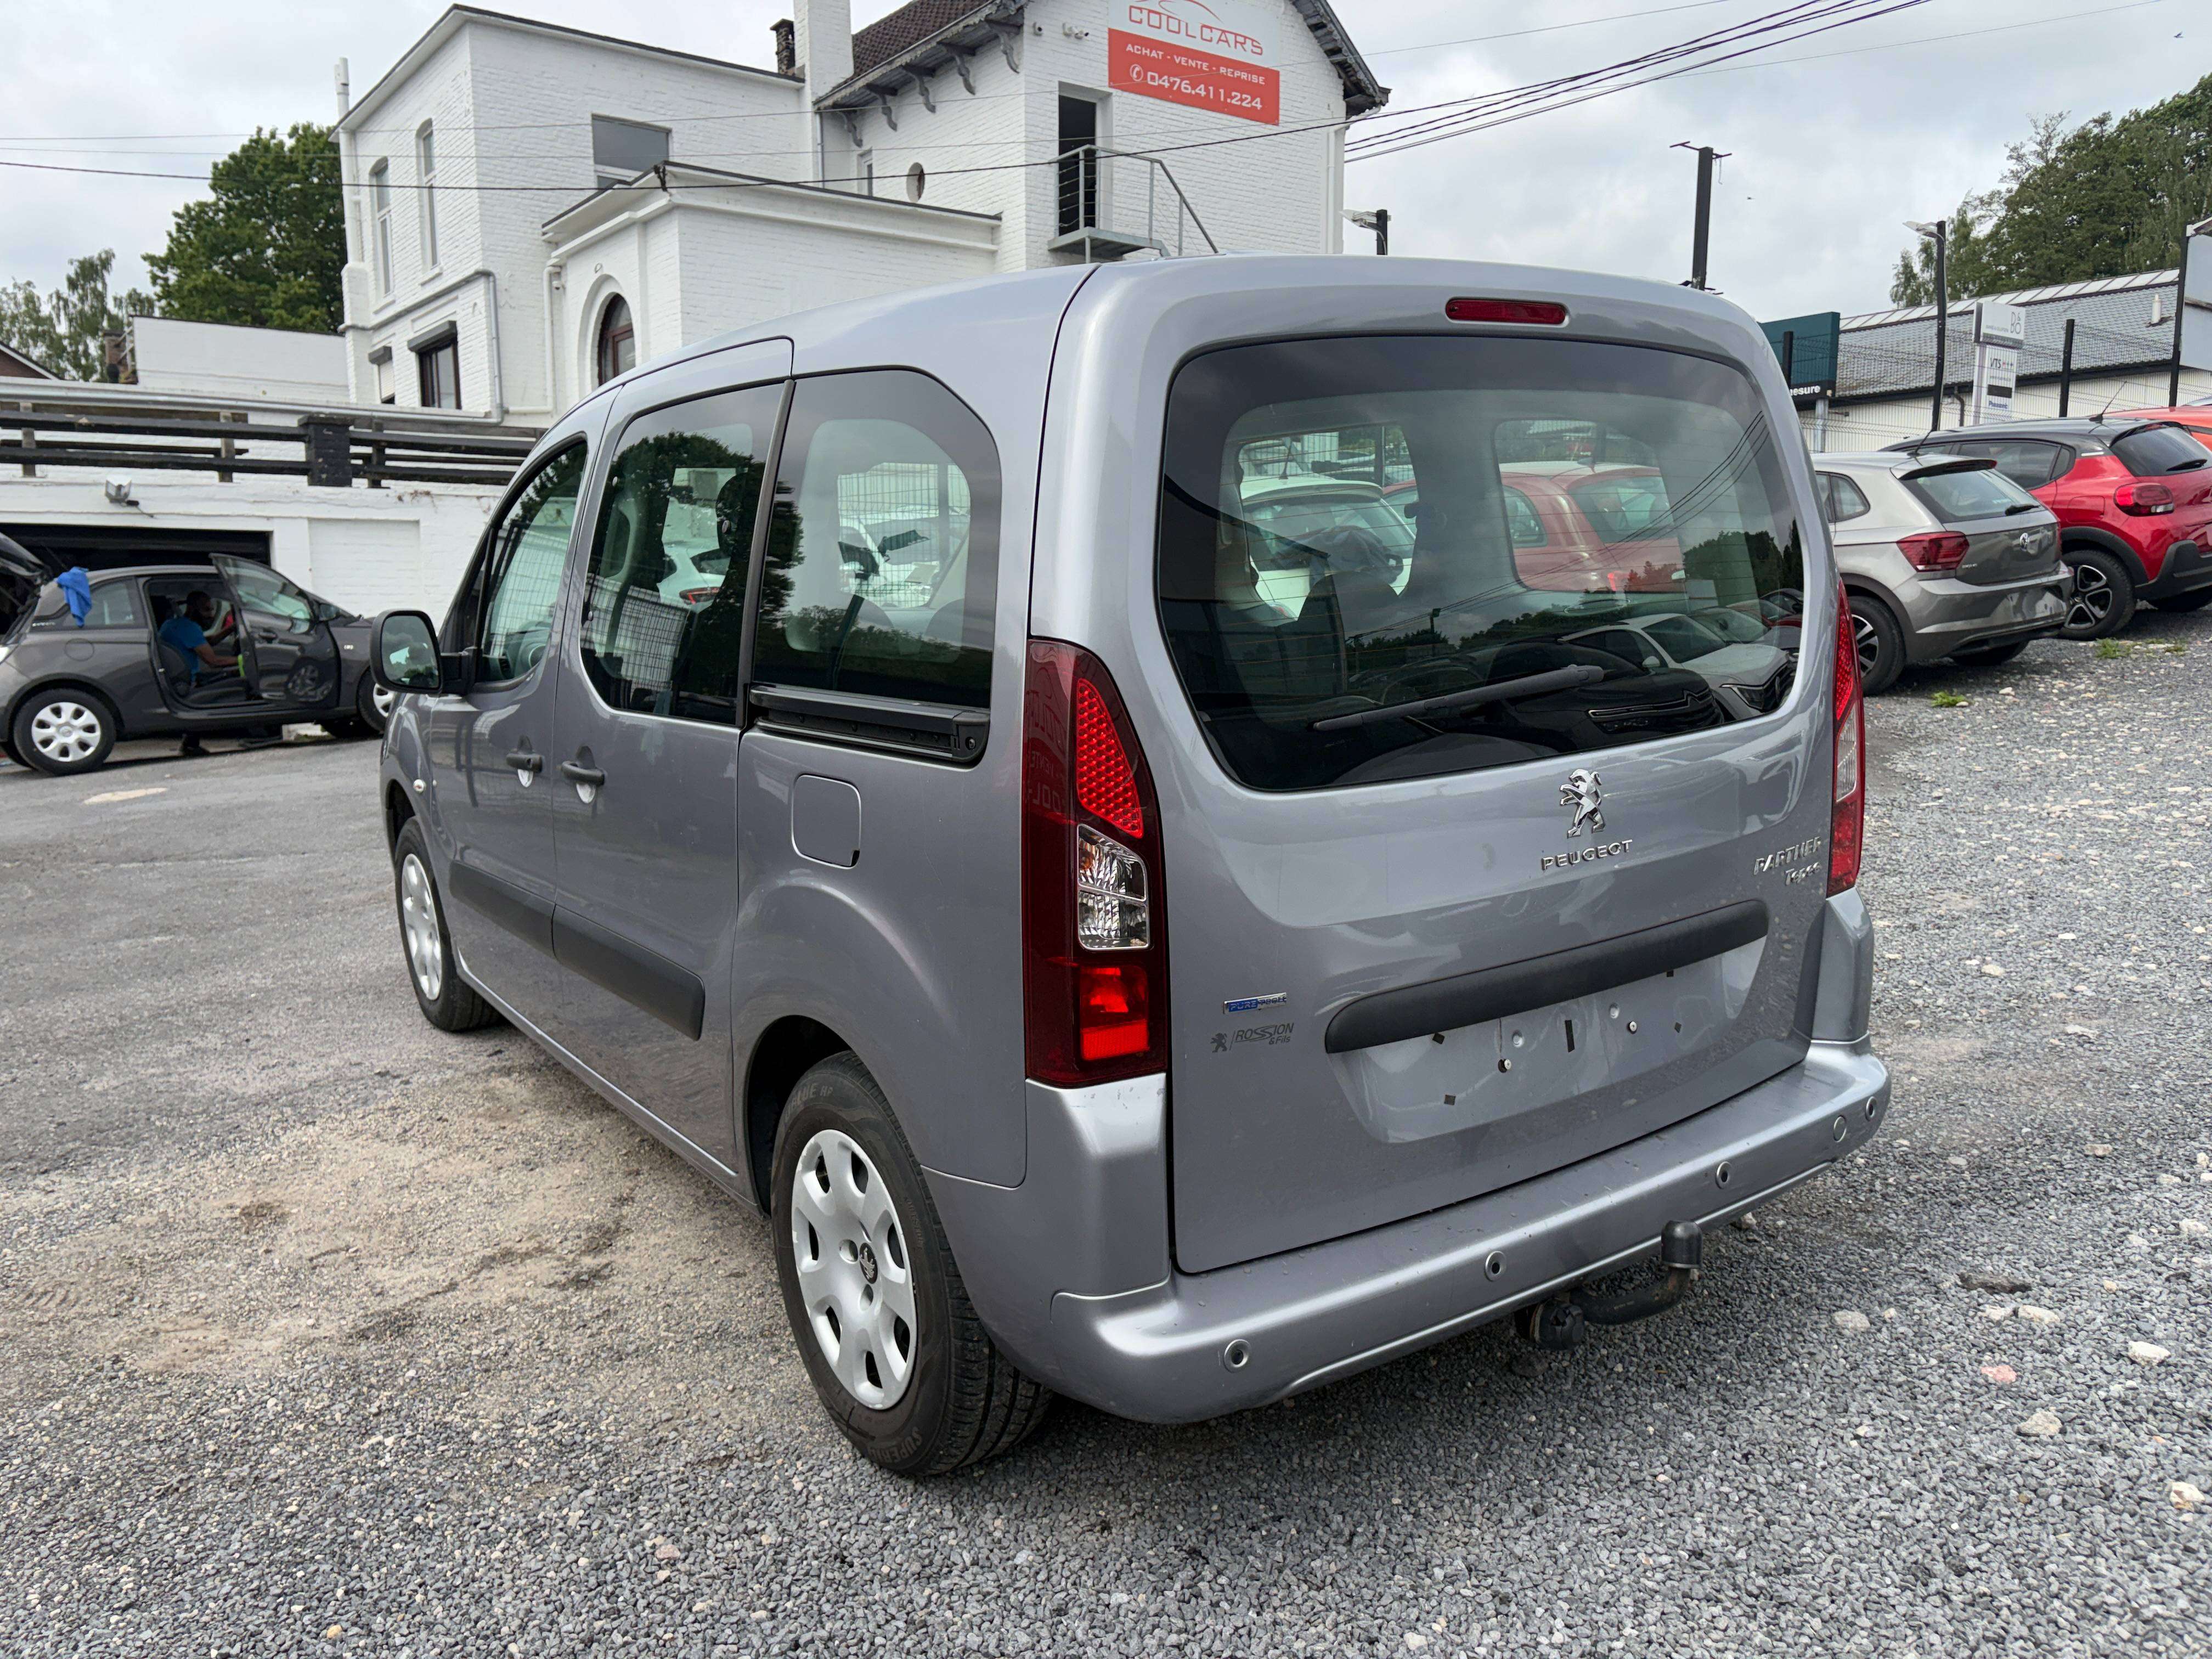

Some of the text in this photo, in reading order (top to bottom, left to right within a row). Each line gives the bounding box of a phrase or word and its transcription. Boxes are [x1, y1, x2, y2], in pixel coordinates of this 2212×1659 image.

[1126, 43, 1164, 60] ACHAT
[1173, 55, 1209, 71] VENTE
[1219, 66, 1265, 84] REPRISE
[1147, 72, 1262, 110] 0476.411.224
[1990, 358, 2001, 369] VTS
[1542, 839, 1633, 871] PEUGEOT
[1754, 836, 1821, 875] PARTNER
[1234, 1023, 1294, 1042] ROSSION
